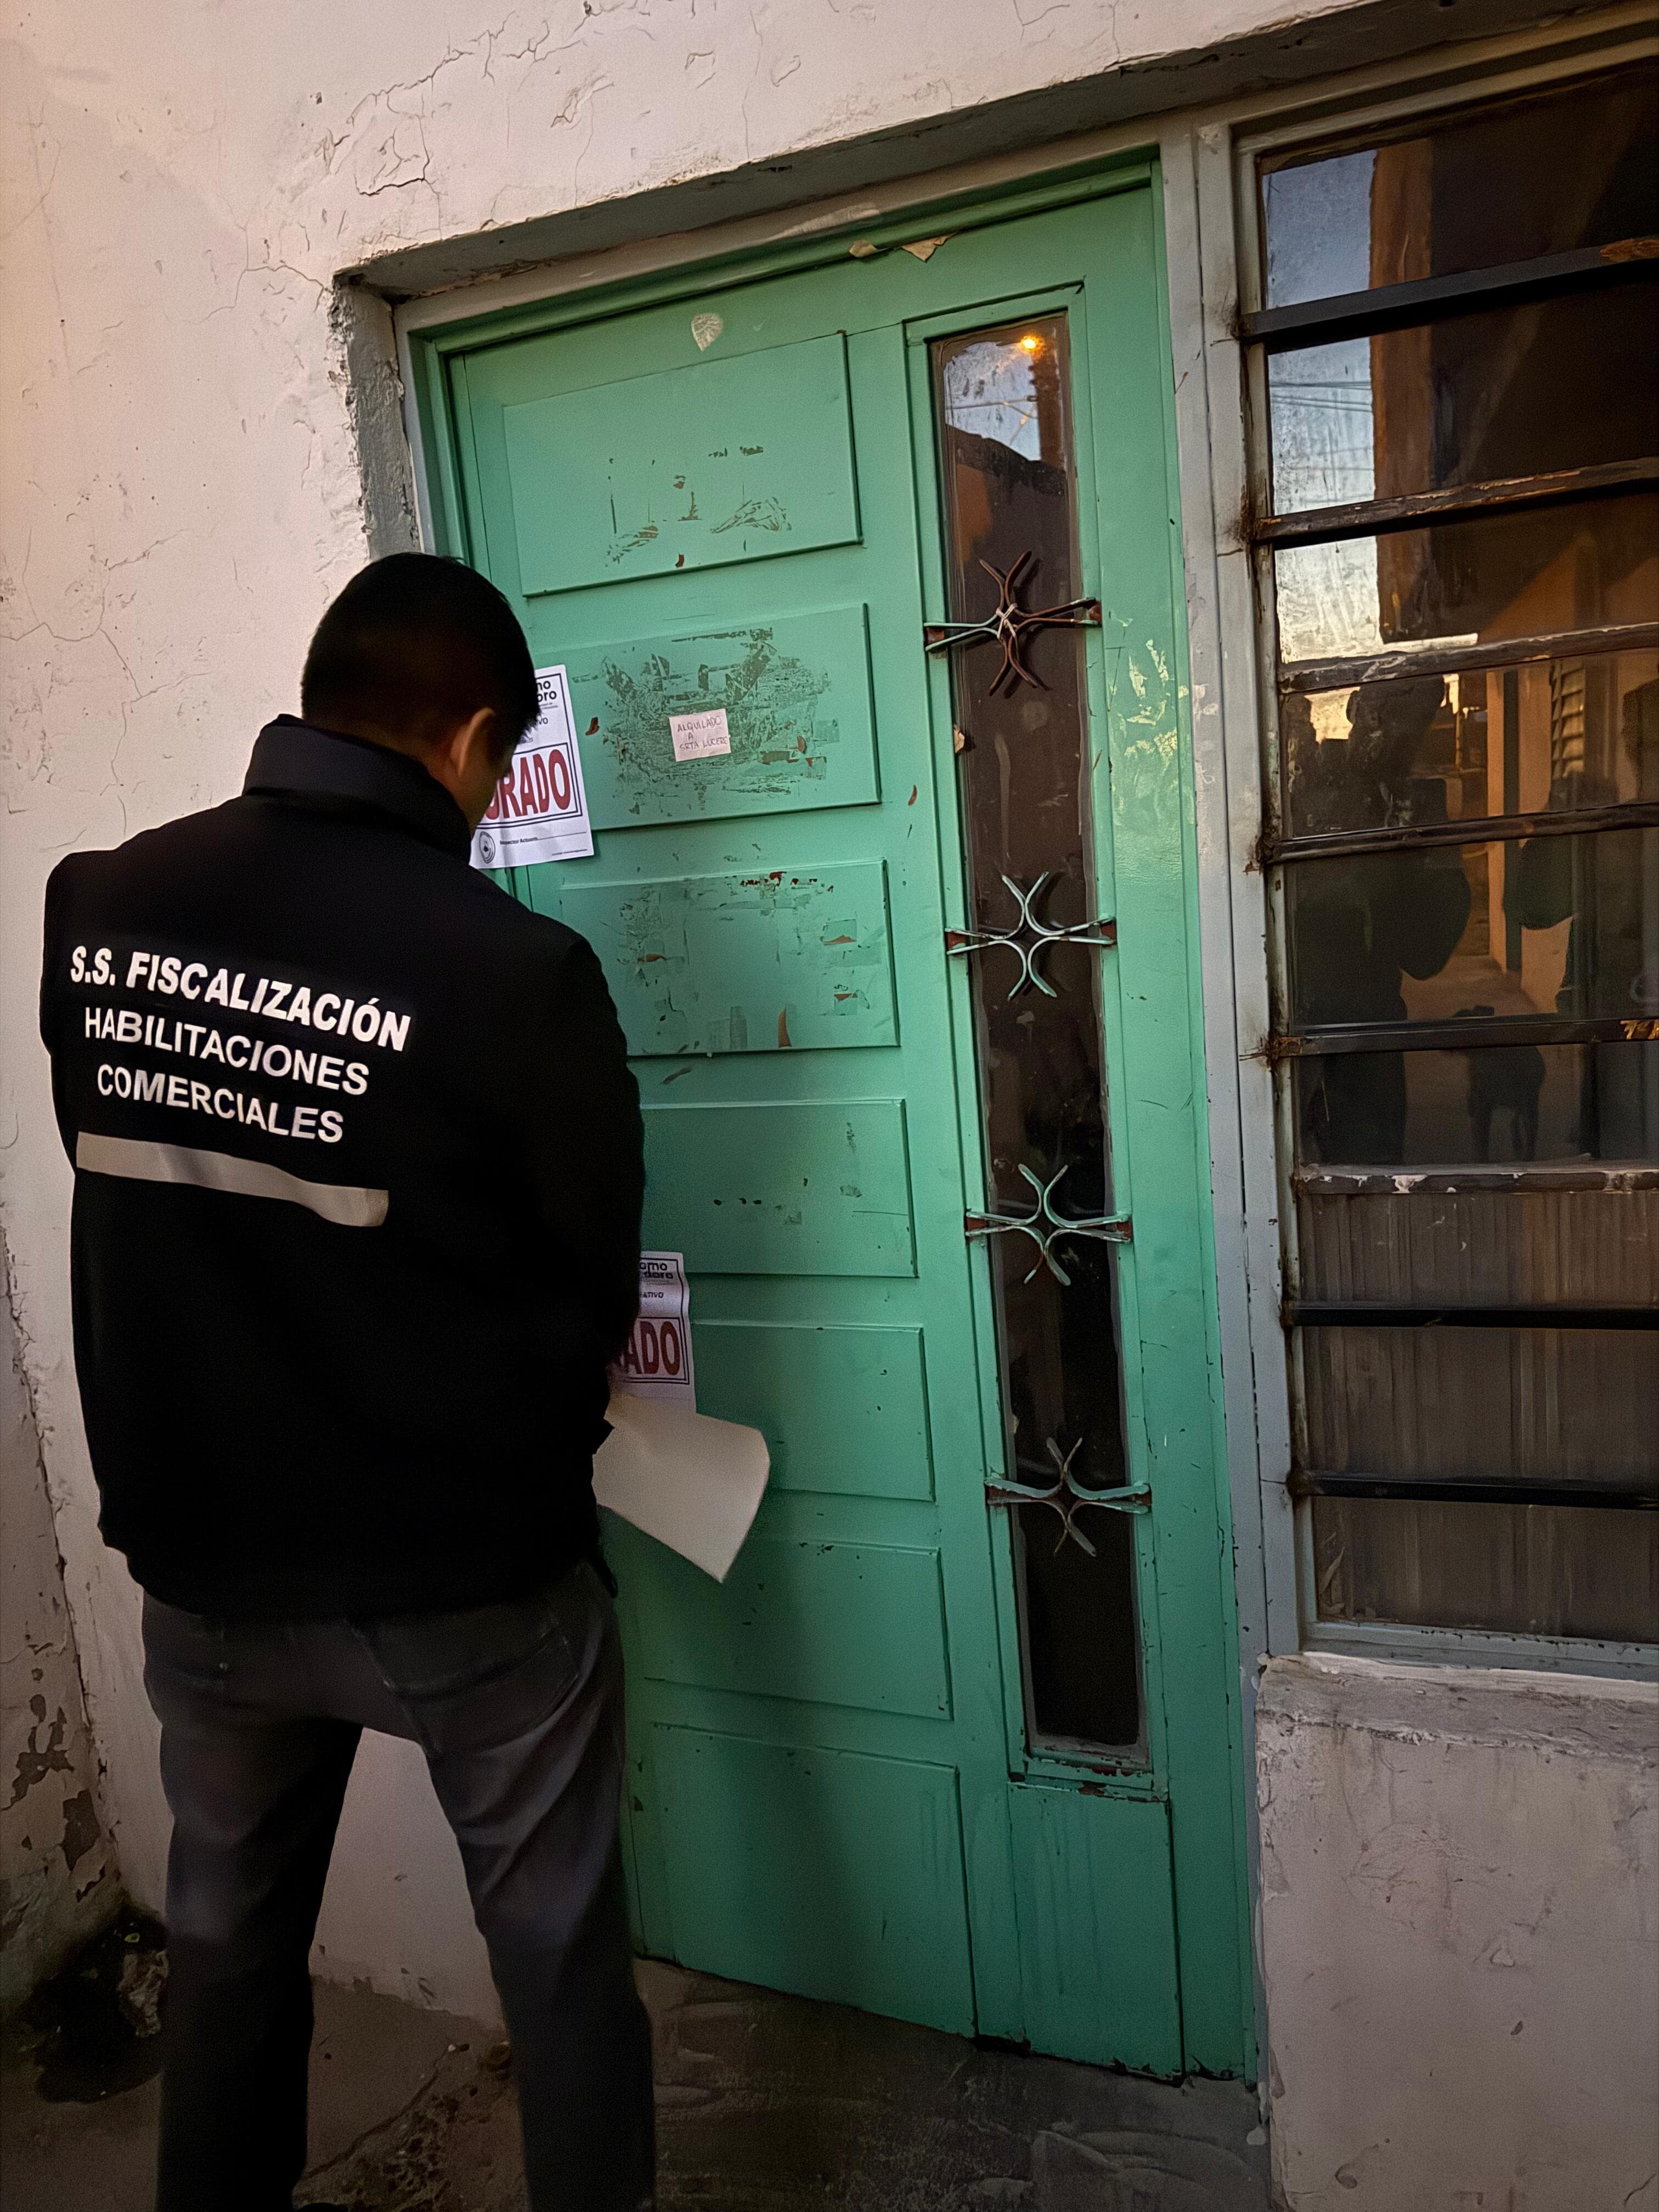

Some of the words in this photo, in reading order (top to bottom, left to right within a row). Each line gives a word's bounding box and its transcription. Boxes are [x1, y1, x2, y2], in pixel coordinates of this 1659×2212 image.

[678, 715, 722, 733] ALQUILADO
[688, 732, 693, 741] A
[71, 946, 116, 985] S.S.
[126, 951, 411, 1052] FISCALIZACIÓN
[84, 1007, 369, 1095] HABILITACIONES
[97, 1064, 344, 1143] COMERCIALES
[622, 1321, 681, 1376] ADO
